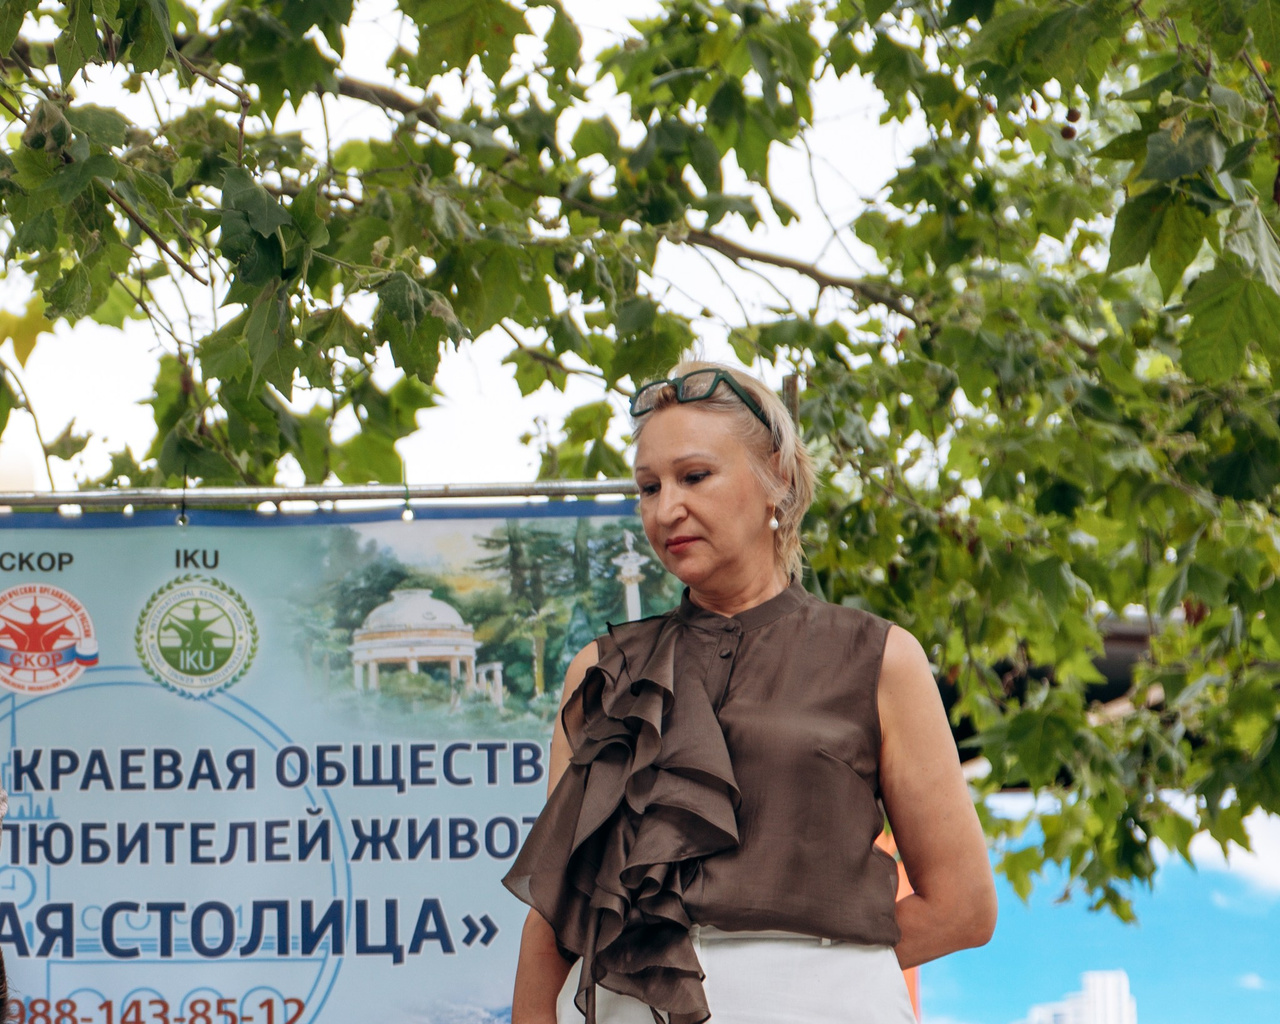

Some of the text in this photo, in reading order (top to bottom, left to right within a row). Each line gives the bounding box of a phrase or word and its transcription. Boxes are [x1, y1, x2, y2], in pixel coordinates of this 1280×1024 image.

[174, 548, 220, 570] IKU
[9, 652, 64, 668] СКОР
[179, 649, 216, 671] IKU
[13, 748, 256, 791] КРАЕВАЯ
[275, 742, 552, 795] ОБЩЕСТВ
[100, 897, 500, 966] СТОЛИЦА»
